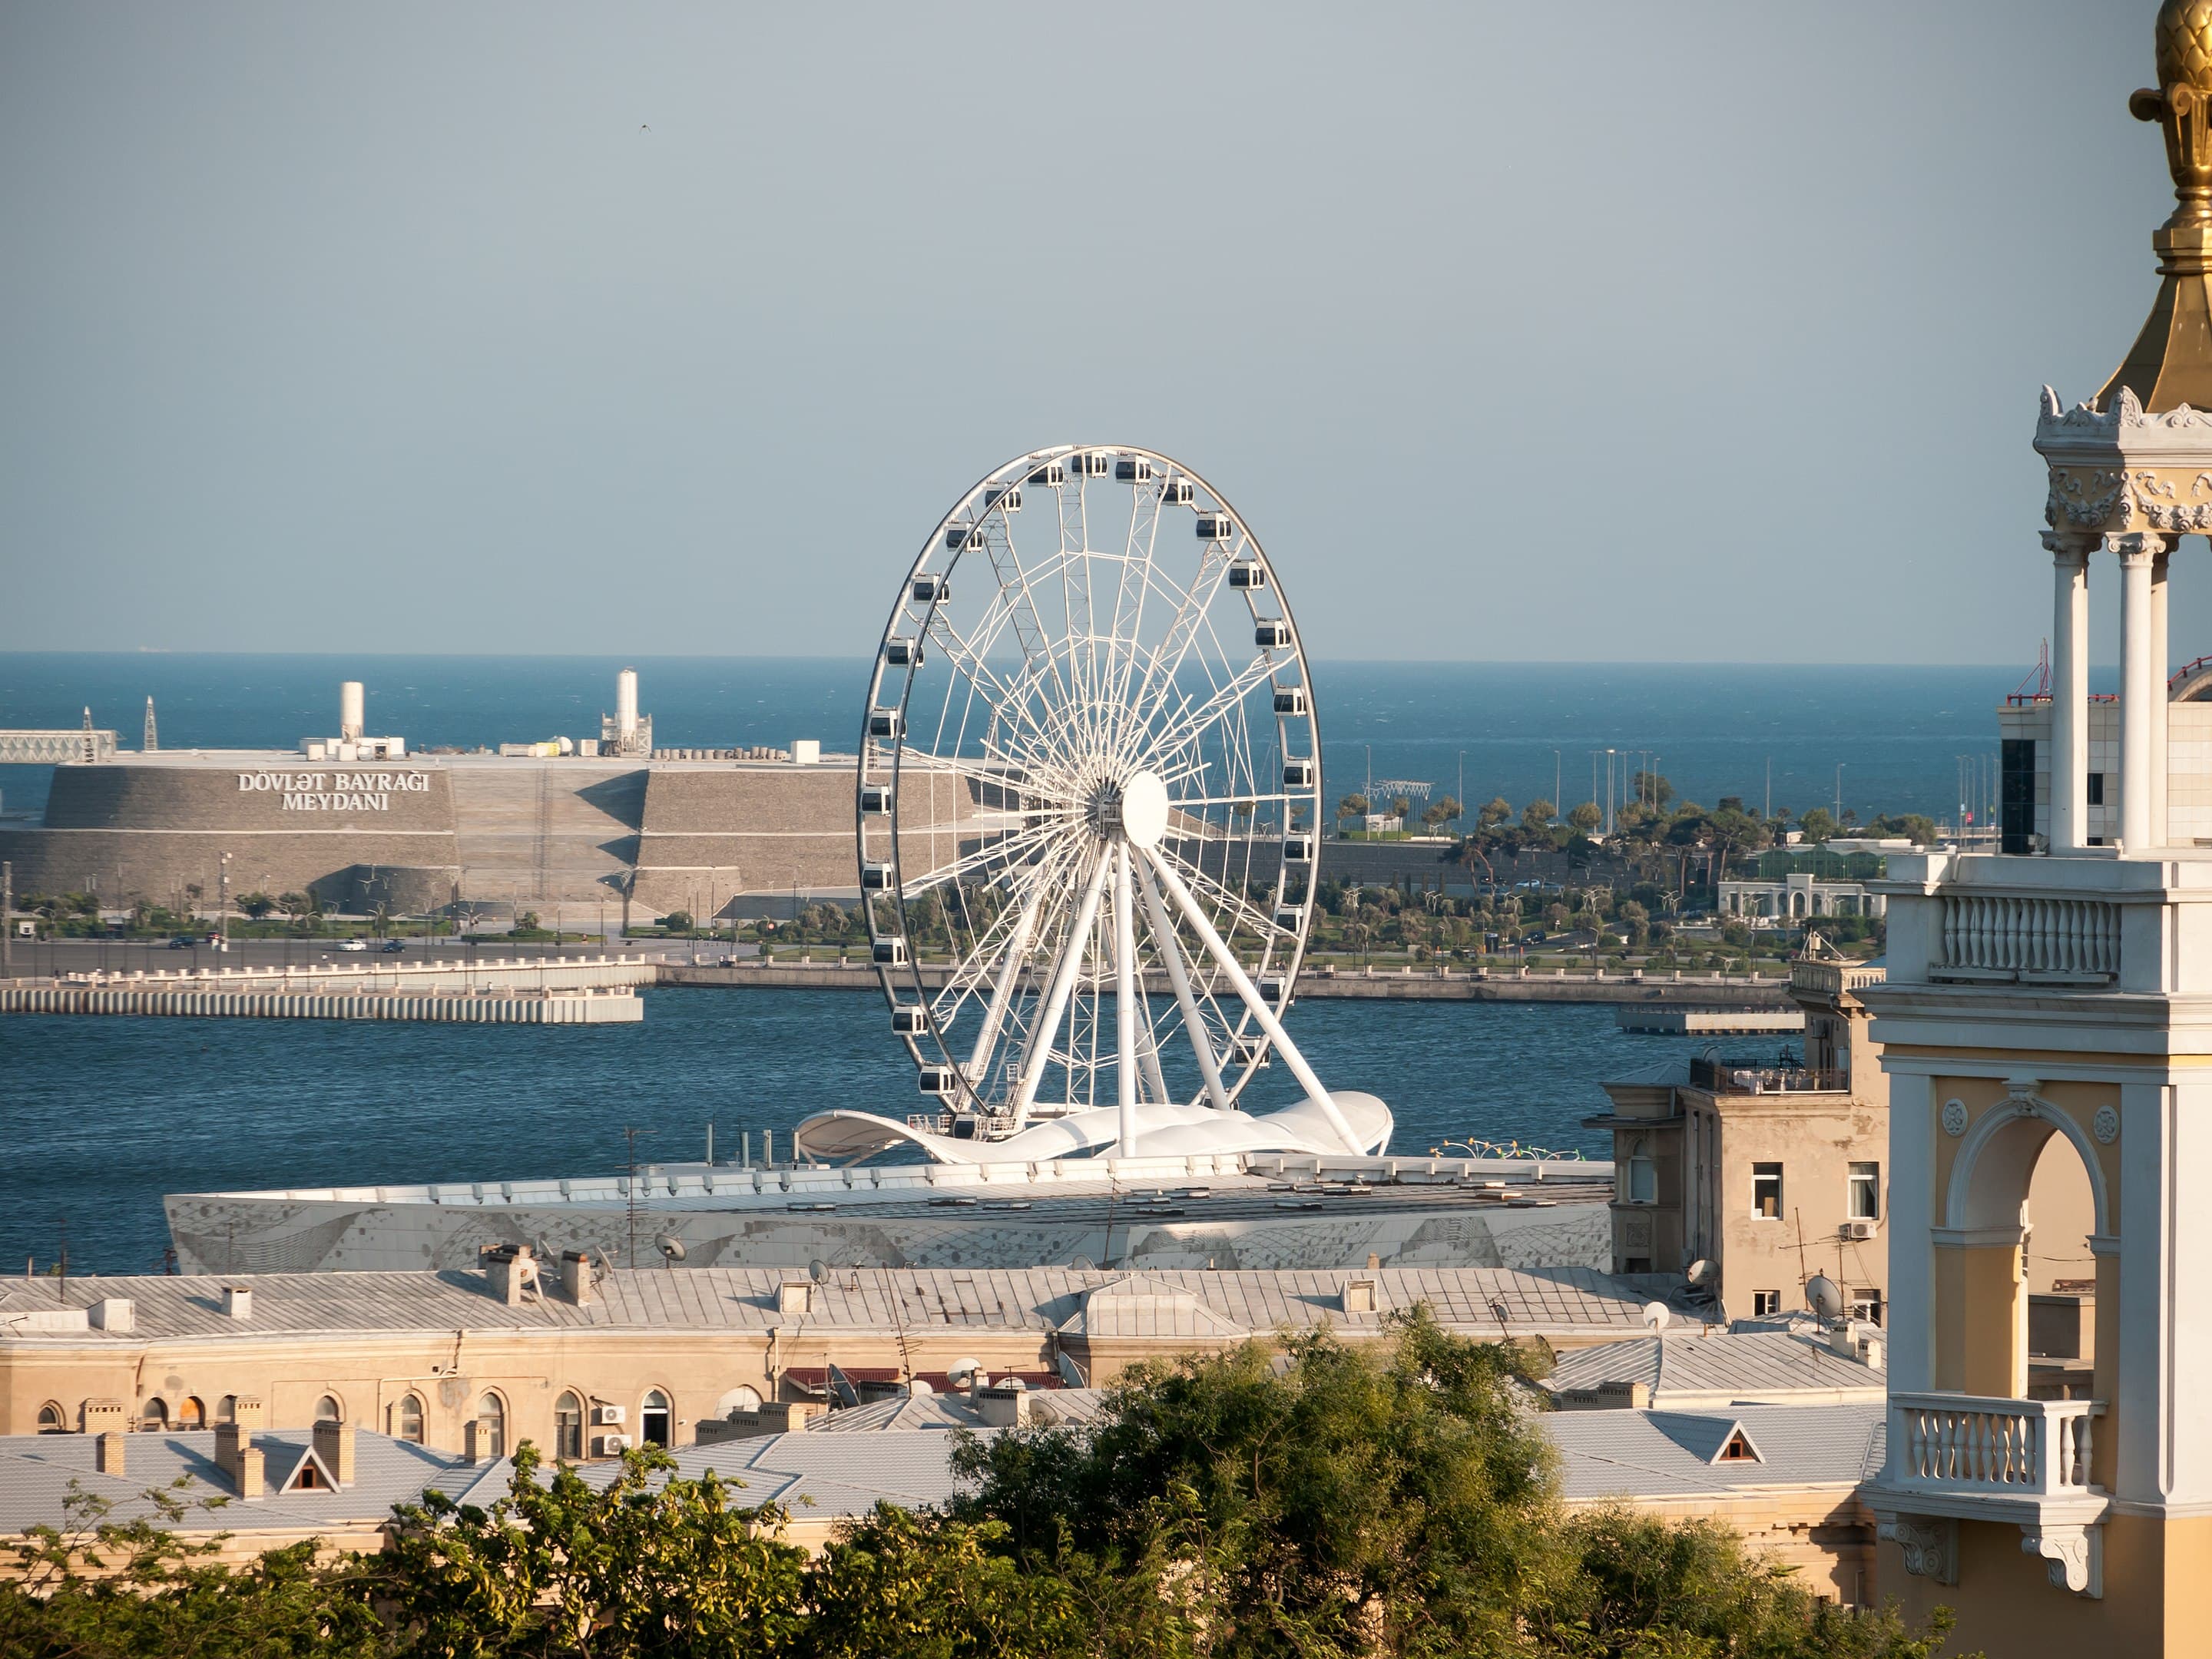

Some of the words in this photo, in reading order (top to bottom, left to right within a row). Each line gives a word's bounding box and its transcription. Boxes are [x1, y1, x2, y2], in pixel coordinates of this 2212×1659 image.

[238, 770, 326, 791] DÖVLƏT
[333, 770, 430, 792] BAYRAĞI
[282, 793, 389, 810] MEYDANI
